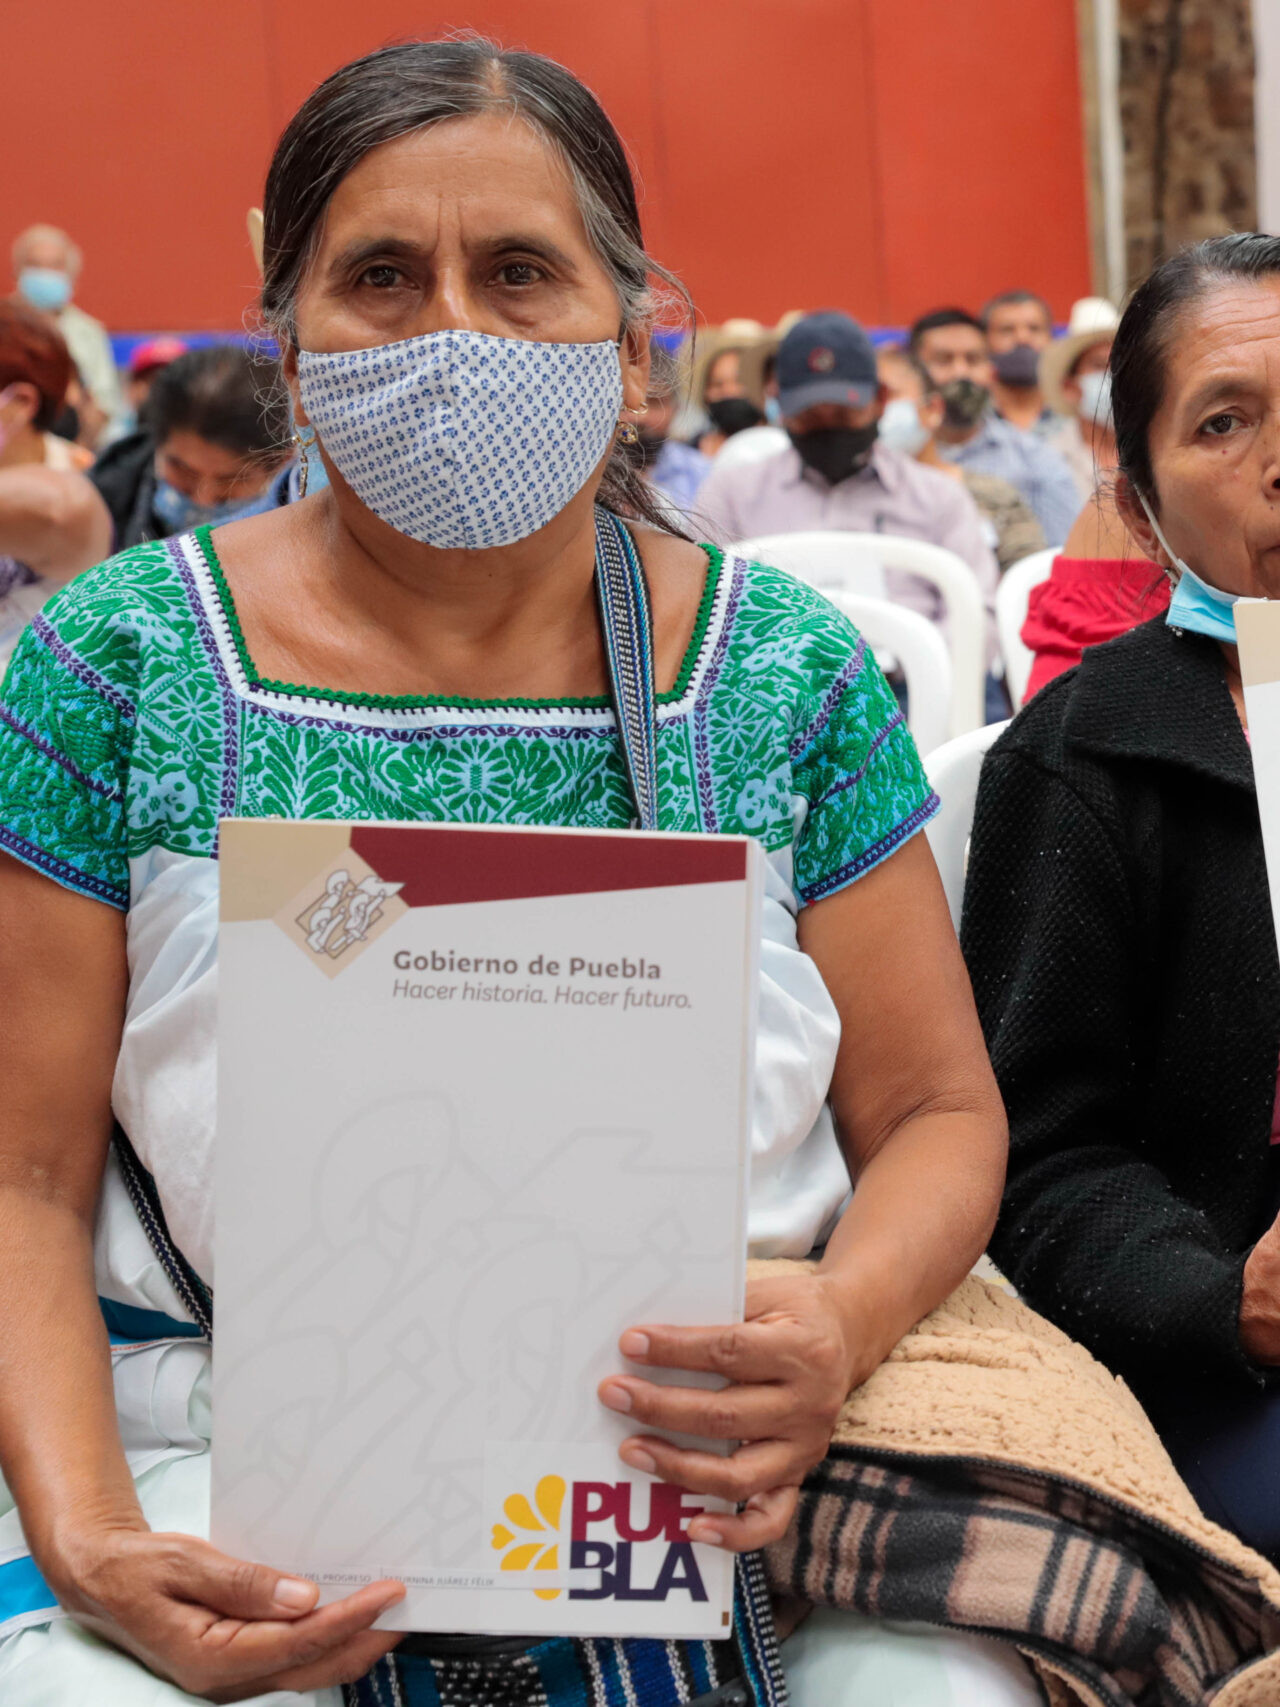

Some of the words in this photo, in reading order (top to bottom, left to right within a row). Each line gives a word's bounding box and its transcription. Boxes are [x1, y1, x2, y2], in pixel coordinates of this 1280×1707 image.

[393, 950, 519, 975] Gobierno
[527, 953, 560, 977] de
[569, 956, 662, 980] Puebla
[392, 978, 458, 1001] Hacer
[461, 980, 548, 1004] historia.
[553, 985, 620, 1008] Hacer
[623, 985, 693, 1012] futuro.
[570, 1481, 706, 1543] PUE
[567, 1540, 709, 1602] BLA
